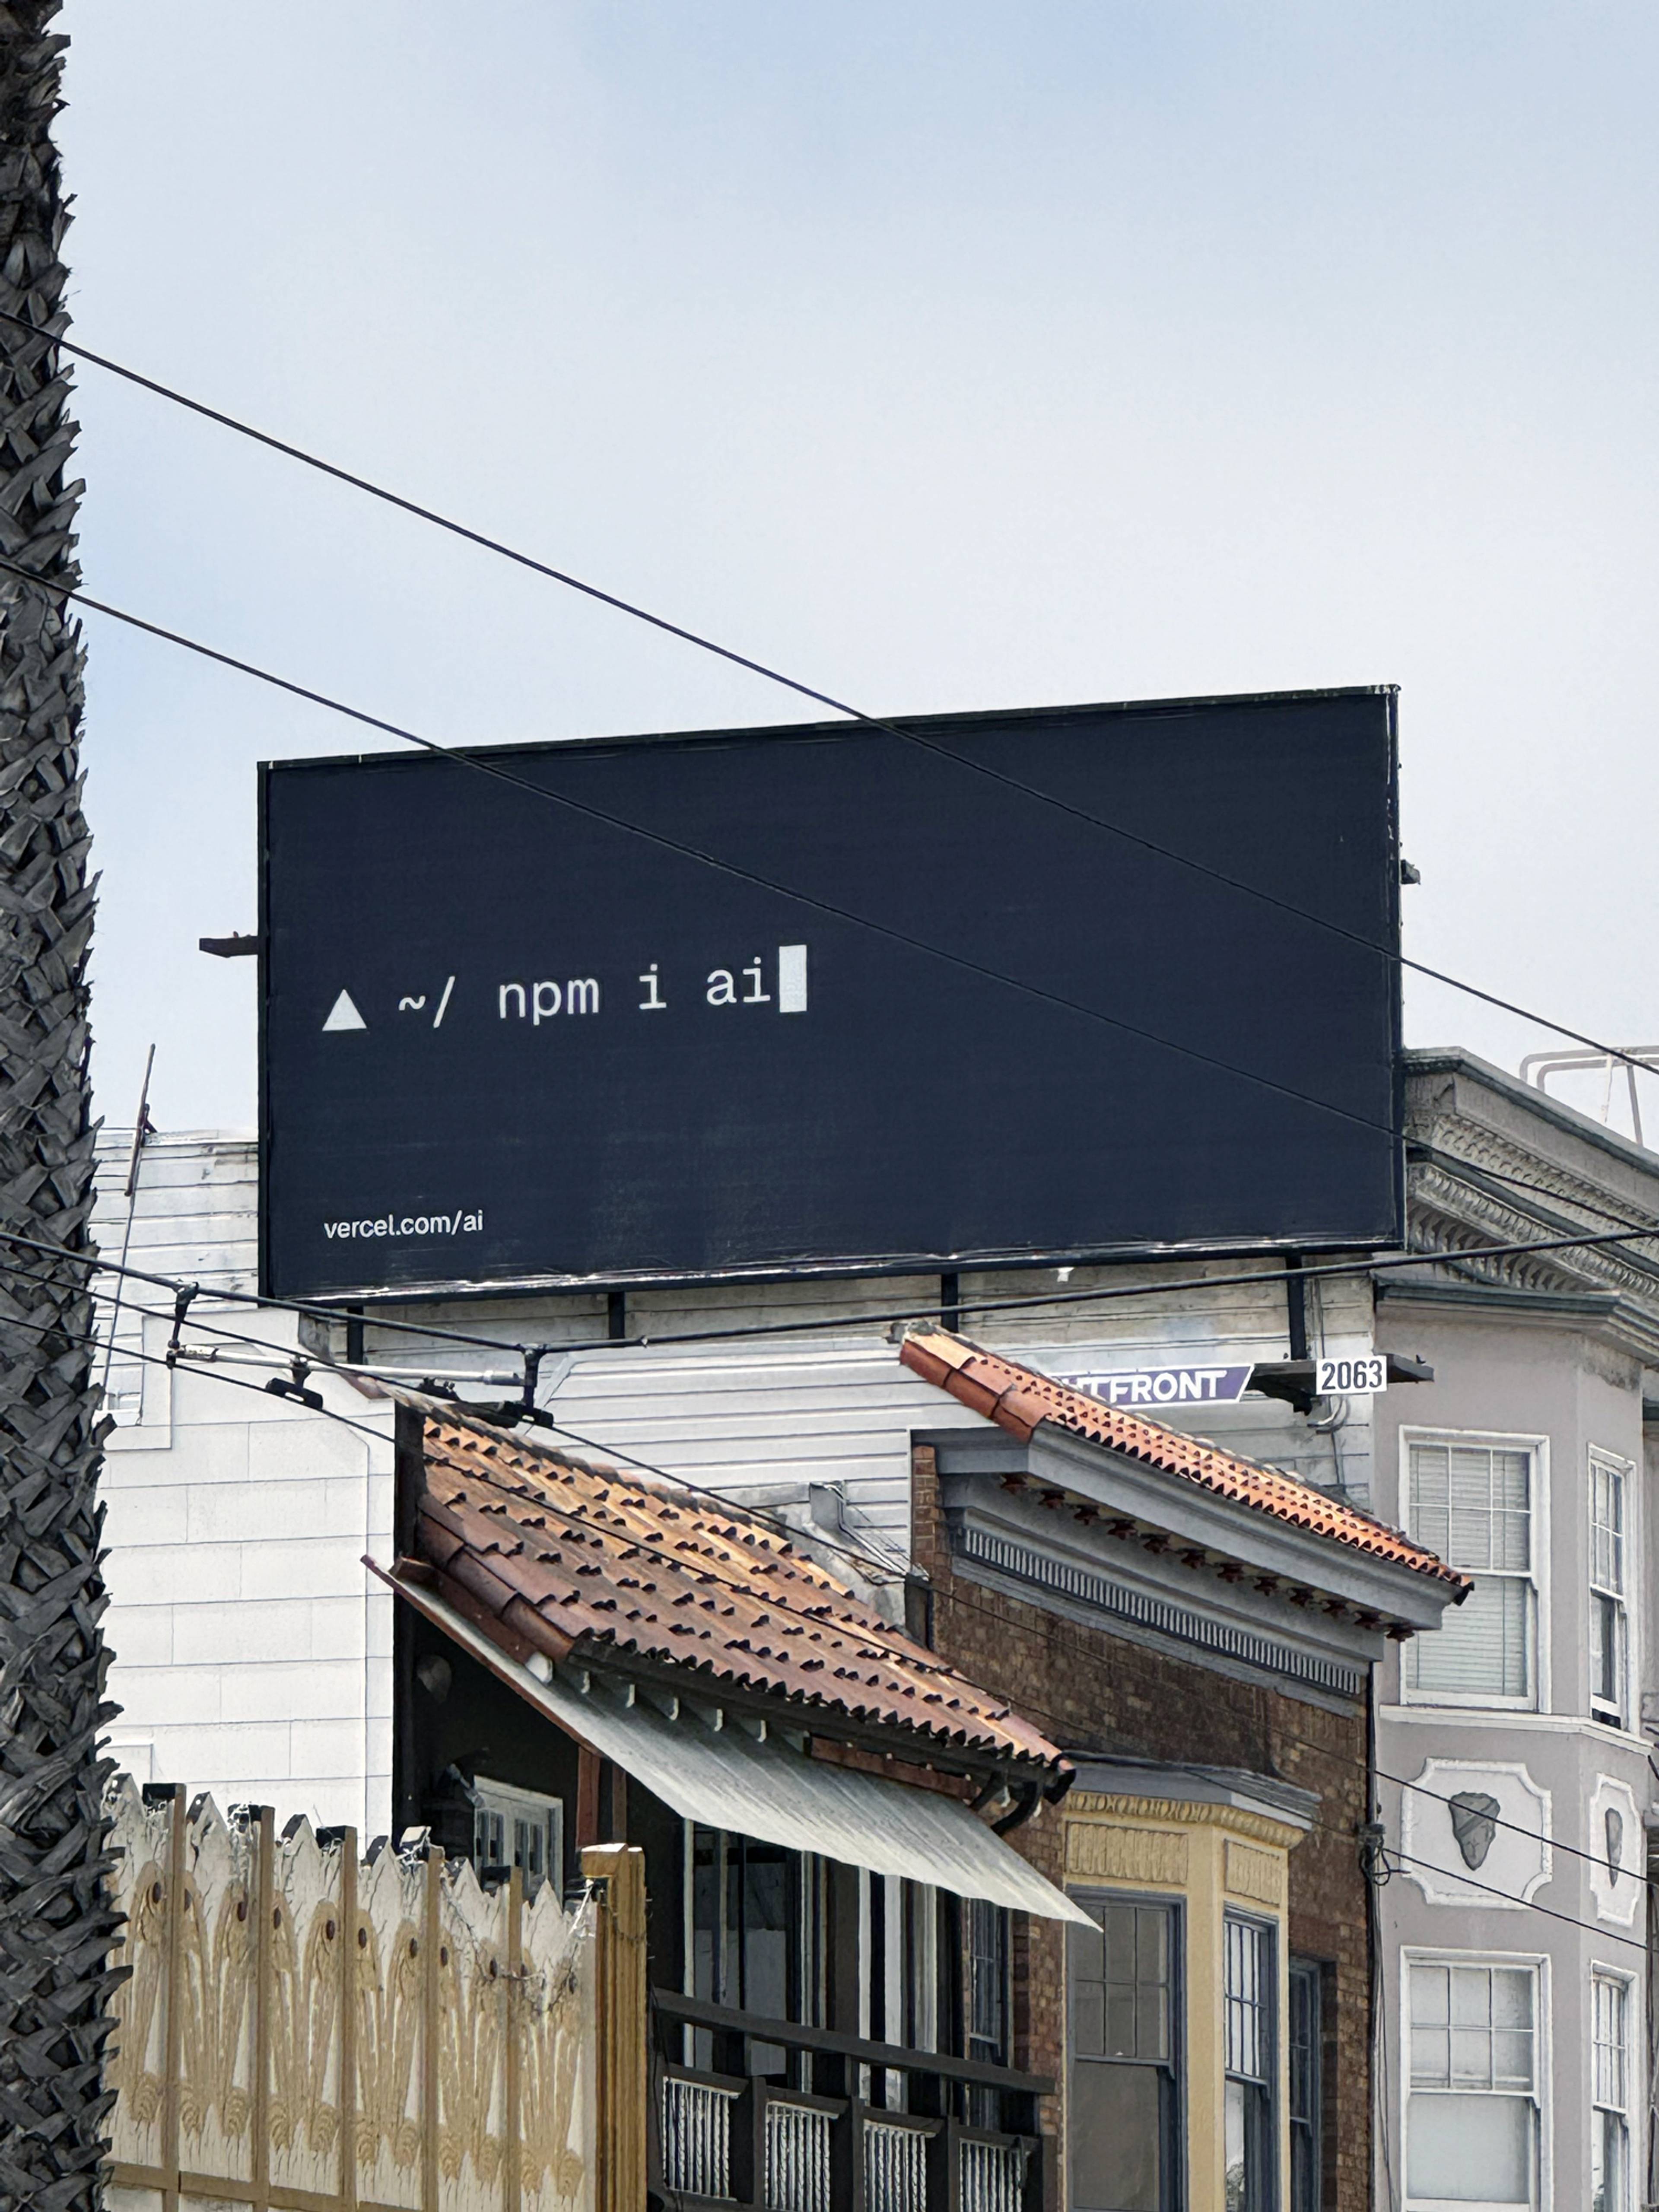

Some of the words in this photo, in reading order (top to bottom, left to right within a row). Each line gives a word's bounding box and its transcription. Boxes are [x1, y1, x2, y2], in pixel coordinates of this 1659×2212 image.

[499, 978, 599, 1026] npm
[639, 963, 667, 1010] i
[706, 957, 771, 1005] ai
[324, 1209, 483, 1239] vercel.com/ai
[1061, 1370, 1227, 1403] TFRONT
[1322, 1360, 1382, 1390] 2063
